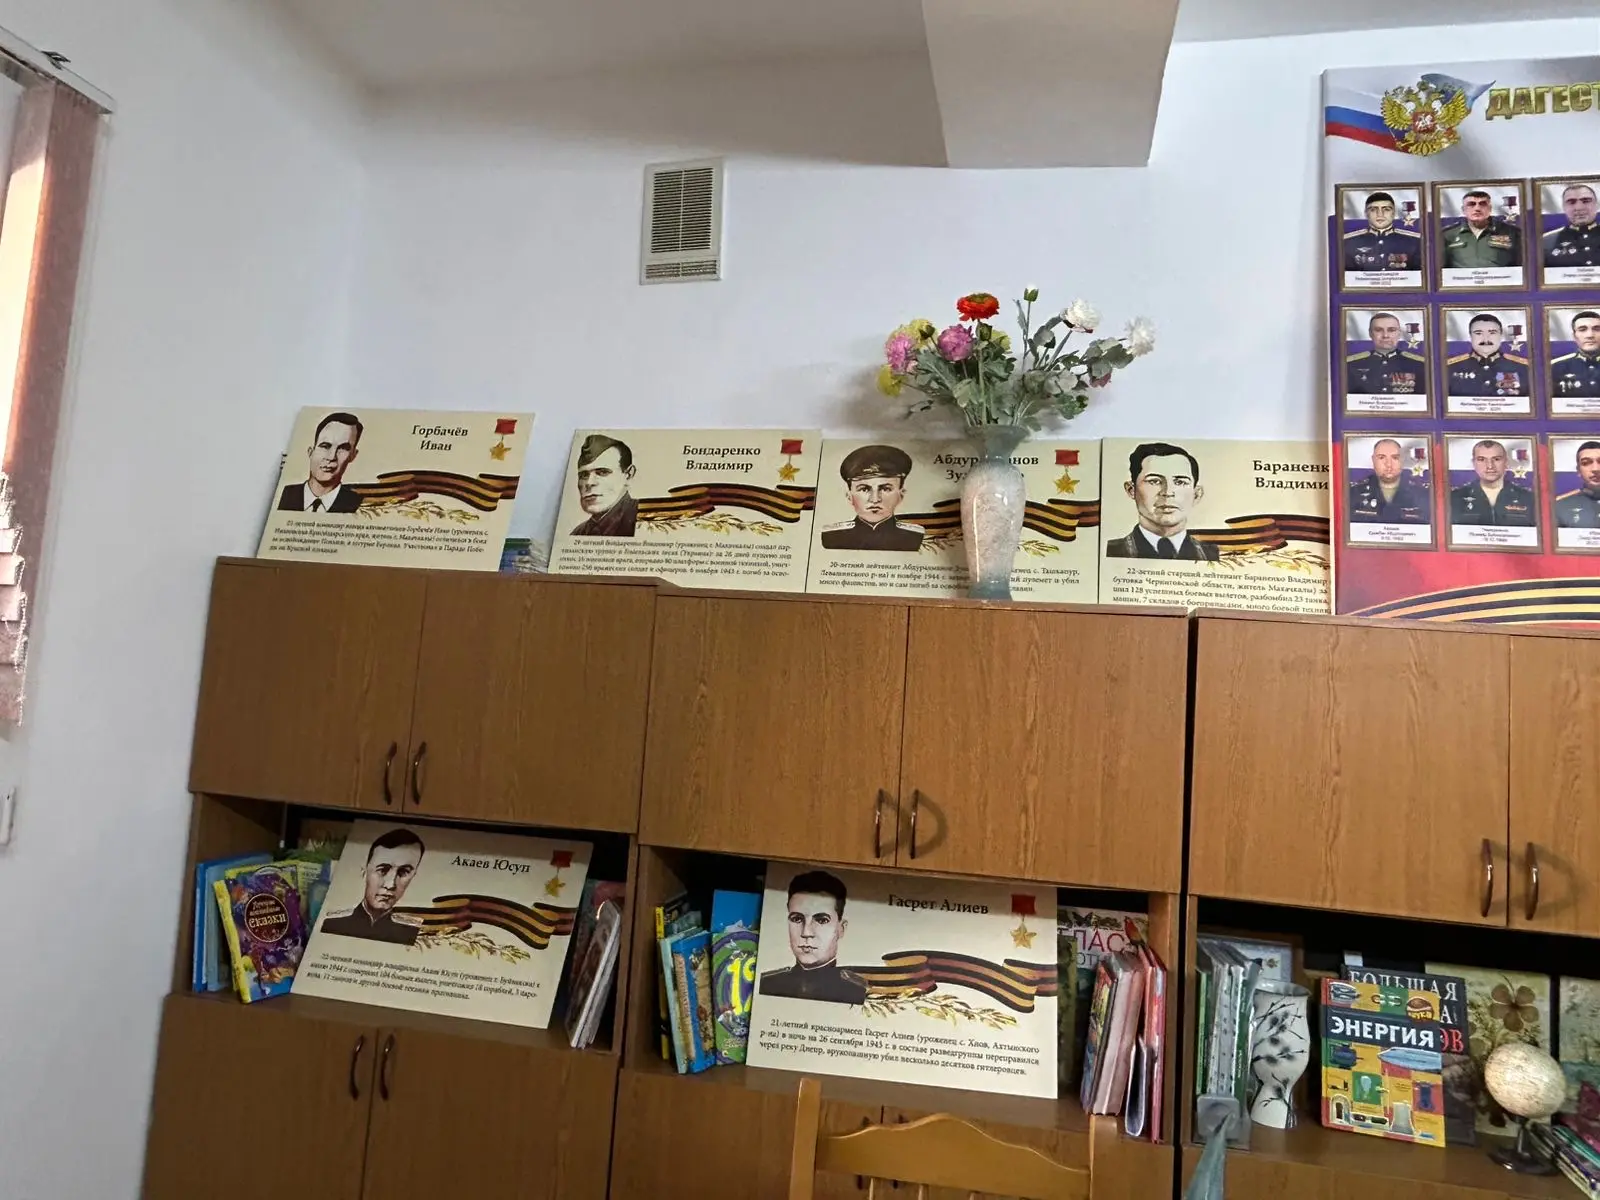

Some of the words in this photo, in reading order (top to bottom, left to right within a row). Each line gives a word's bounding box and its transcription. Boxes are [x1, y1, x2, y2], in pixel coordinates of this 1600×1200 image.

[411, 424, 469, 438] Горбачёв
[420, 440, 452, 451] Иван
[682, 445, 761, 458] Бондаренко
[685, 460, 754, 473] Владимир
[933, 453, 1039, 468] Абдурнов
[1252, 460, 1330, 475] Бараненк
[1255, 477, 1329, 490] Владими
[451, 855, 490, 869] Акаев
[492, 859, 531, 875] Юсуп
[888, 894, 935, 912] Гасрет
[940, 898, 989, 914] Алиев
[810, 1024, 863, 1037] красноармеец
[865, 1028, 889, 1040] Гасрет
[891, 1030, 915, 1041] Алиев
[1330, 1016, 1434, 1049] ЭНЕРГИЯ
[780, 1042, 797, 1053] реку
[830, 1037, 864, 1049] сентября
[899, 1044, 928, 1053] составе
